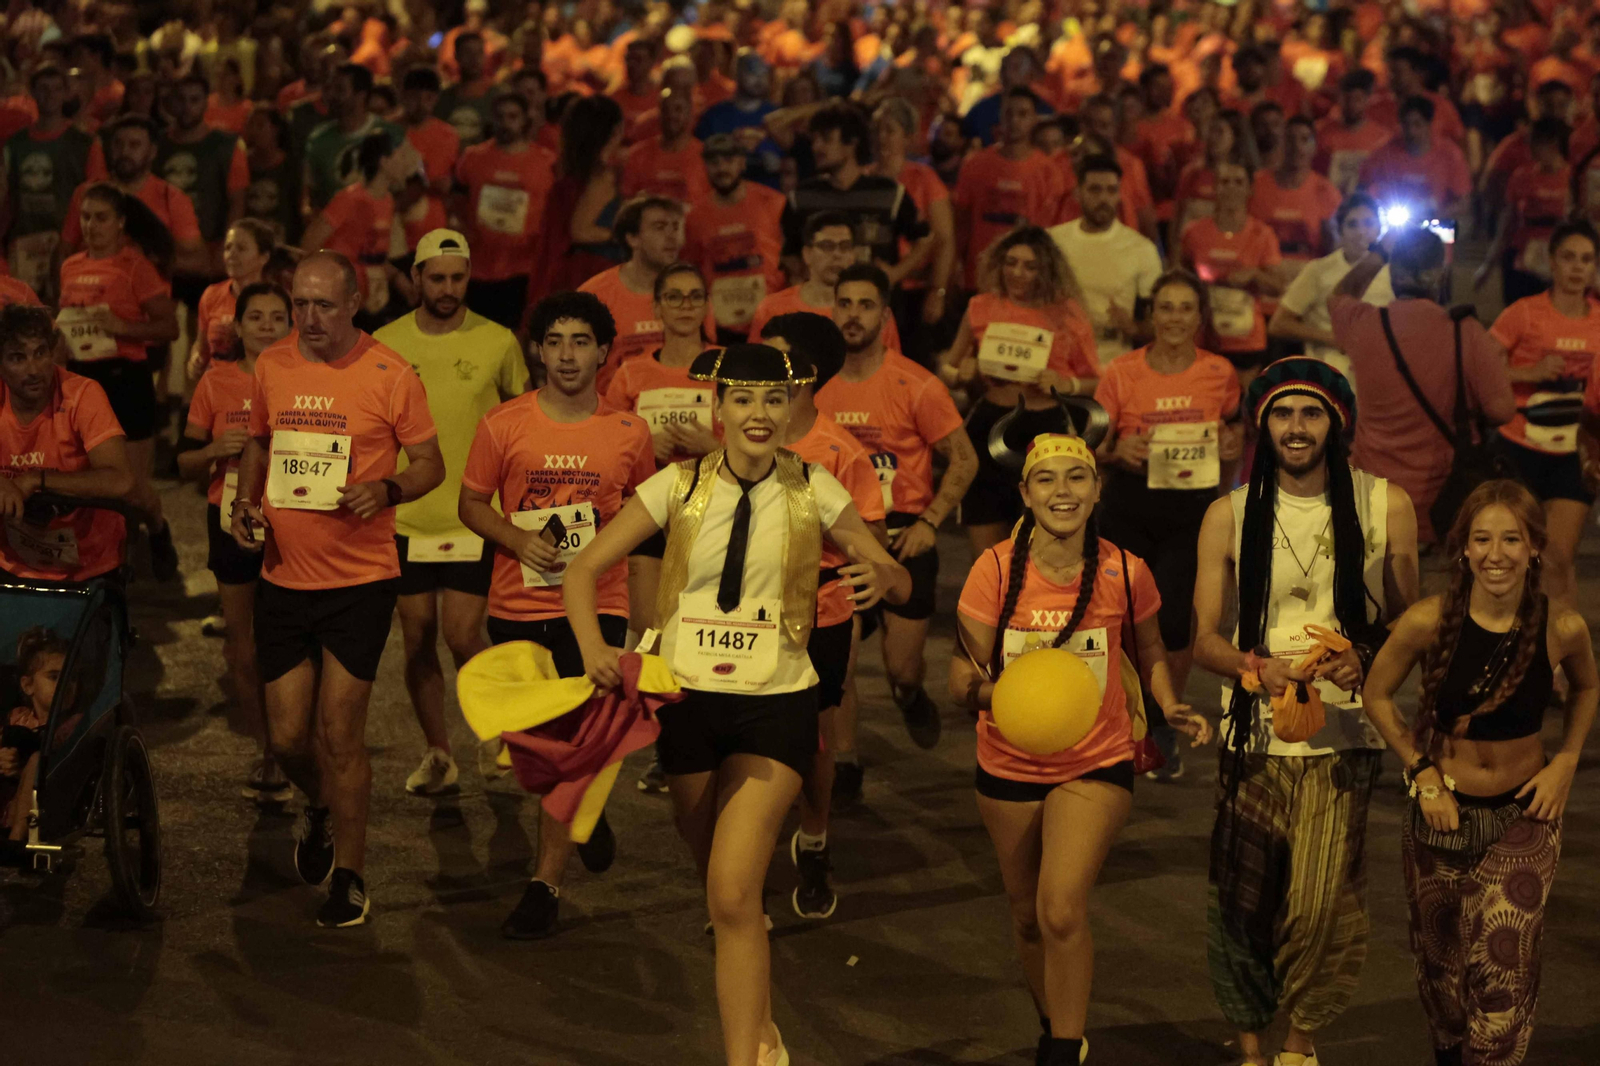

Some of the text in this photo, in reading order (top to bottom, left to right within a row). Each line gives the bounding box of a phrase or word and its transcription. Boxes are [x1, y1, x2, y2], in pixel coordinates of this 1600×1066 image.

[997, 343, 1032, 360] 6196
[292, 395, 335, 411] XXXV
[277, 410, 348, 421] CARRERA NOCTURNA
[279, 417, 347, 430] GUADALQUIVIR
[834, 411, 871, 424] XXXV
[9, 451, 45, 467] XXXV
[1163, 446, 1206, 460] 12228
[282, 458, 333, 477] 18947
[543, 454, 588, 470] XXXV
[530, 477, 600, 487] GUADALQUIVIR
[561, 470, 601, 479] NOCTURNA
[1030, 610, 1073, 627] XXX
[695, 628, 759, 651] 11487
